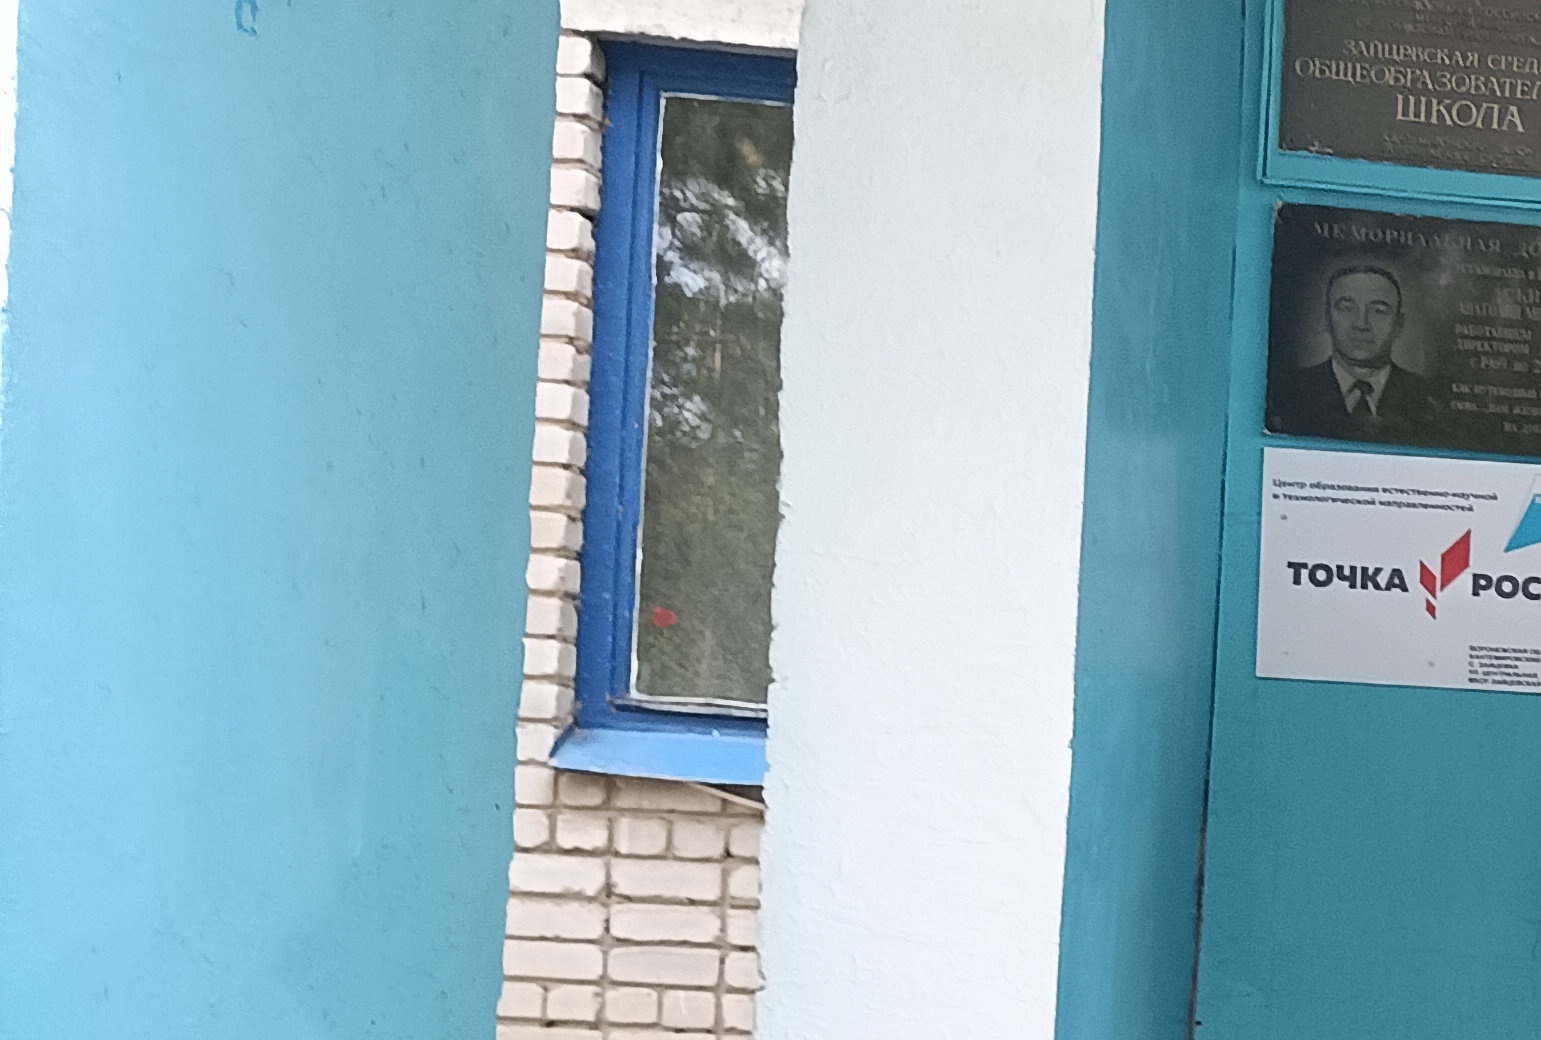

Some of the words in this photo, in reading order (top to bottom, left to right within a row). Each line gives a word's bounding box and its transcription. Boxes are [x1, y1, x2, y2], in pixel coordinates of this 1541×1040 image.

[1343, 39, 1479, 68] ЗАЙЦЕВСКАЯ
[1396, 93, 1525, 133] ШКОЛА
[1287, 561, 1409, 593] ТОЧКА
